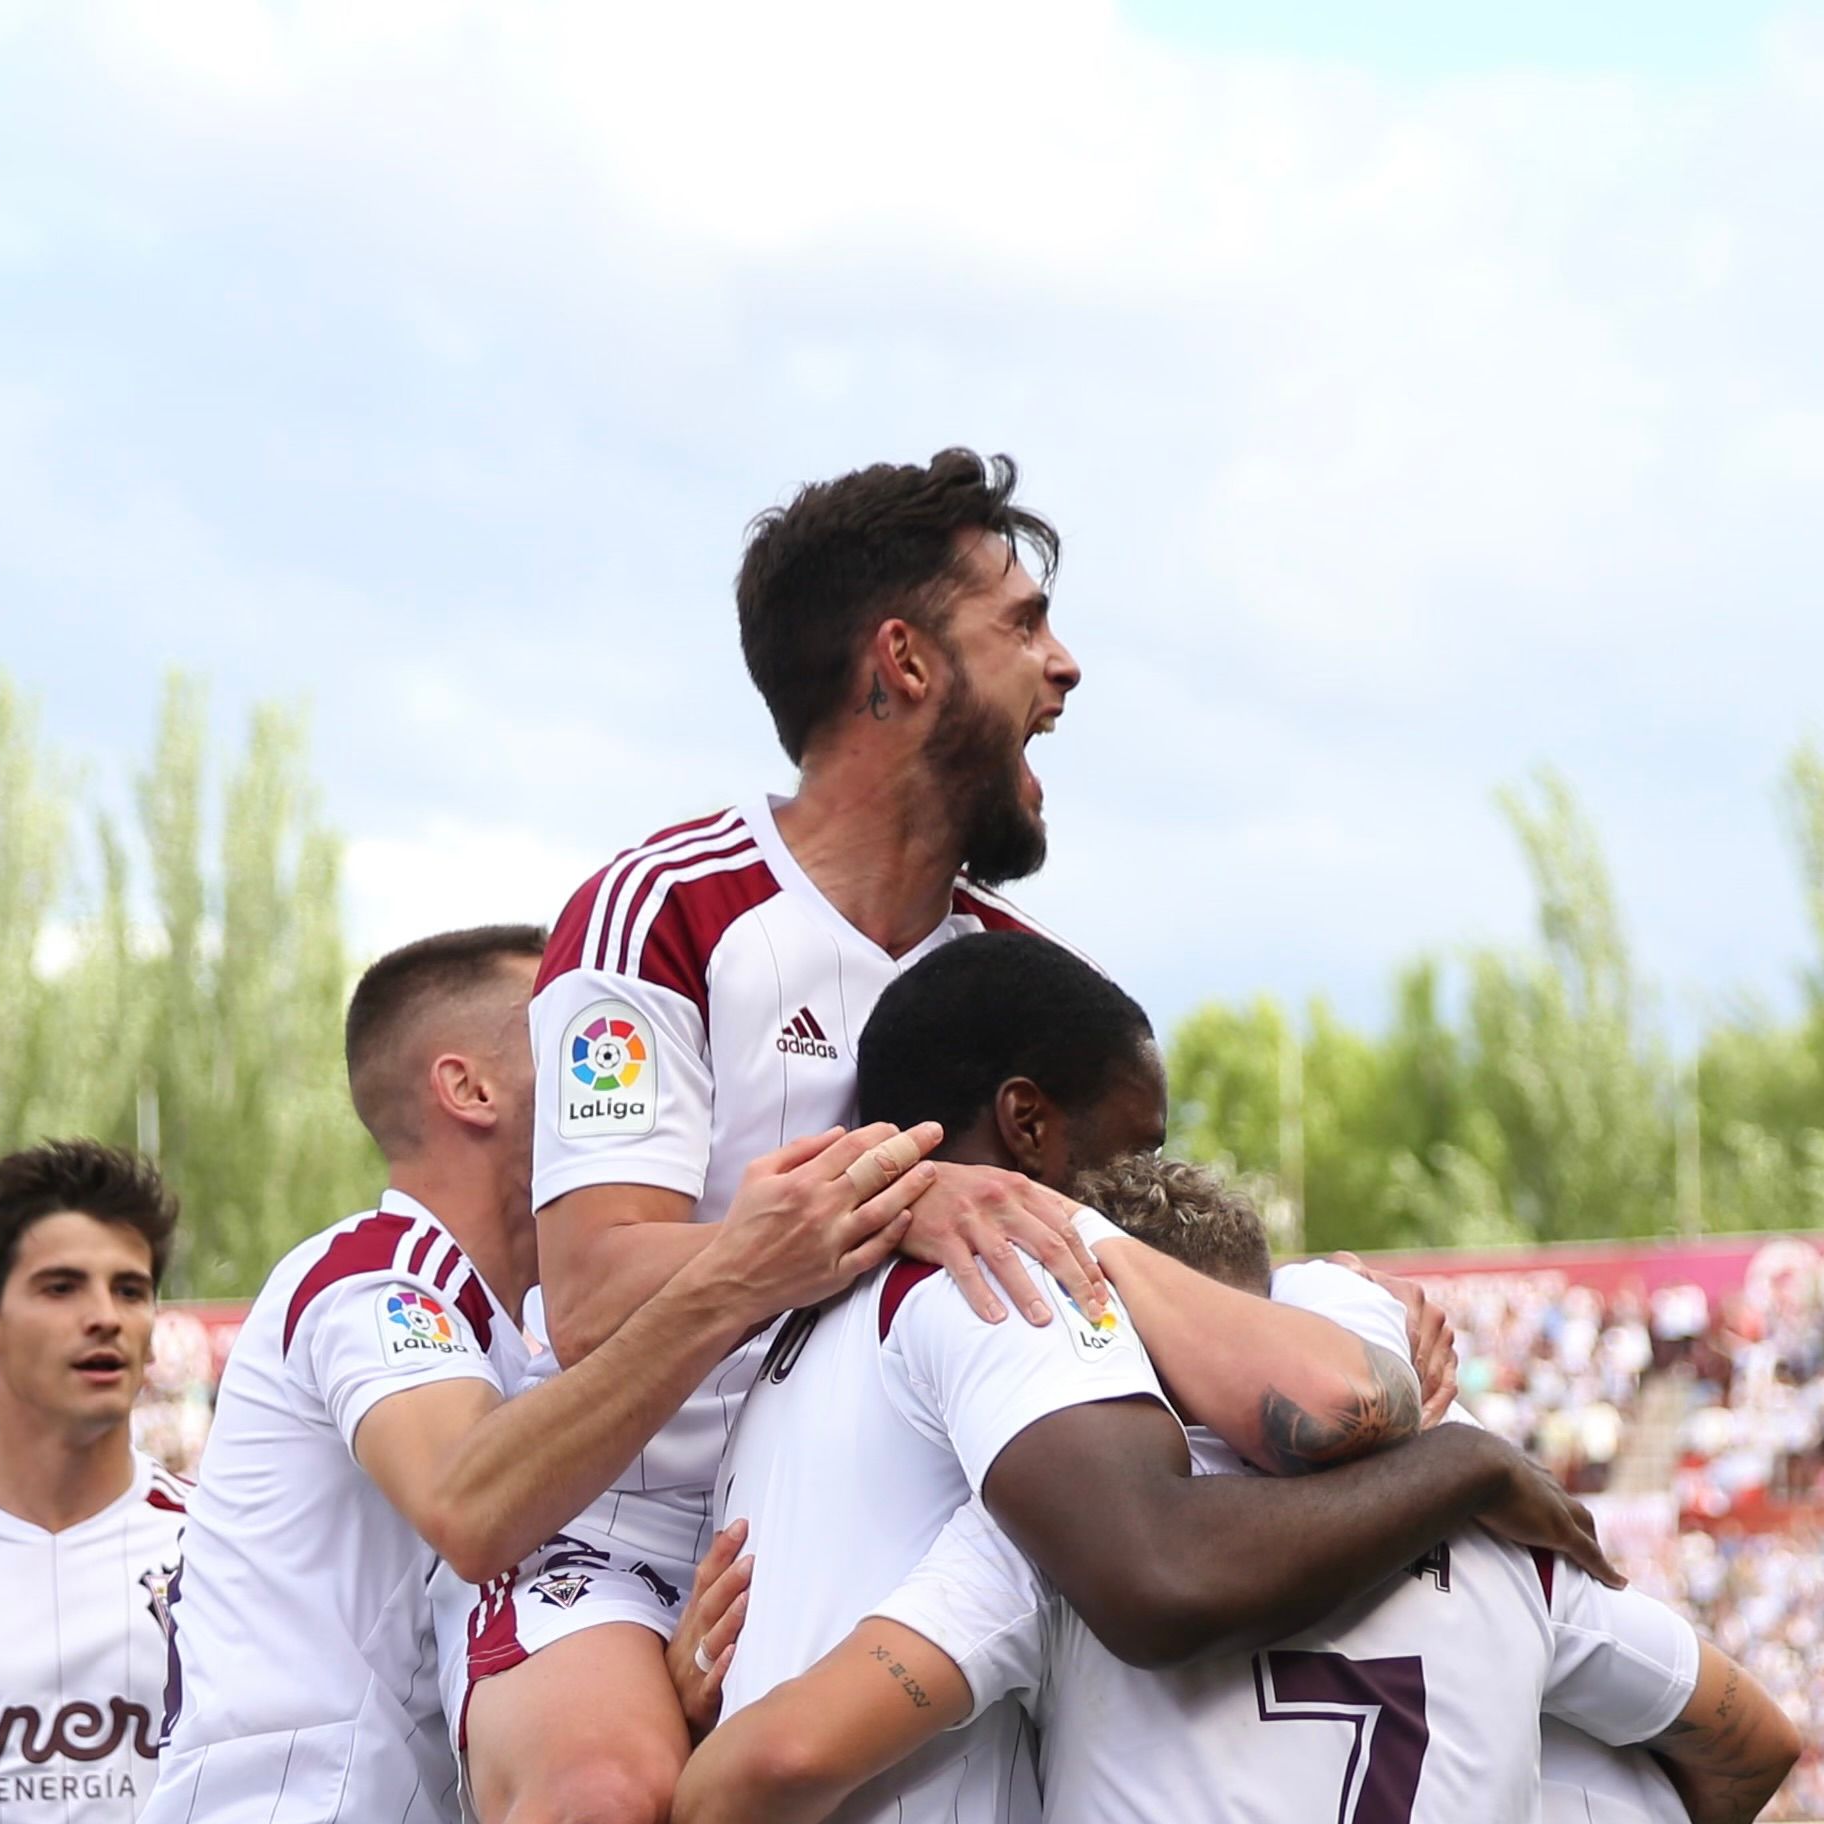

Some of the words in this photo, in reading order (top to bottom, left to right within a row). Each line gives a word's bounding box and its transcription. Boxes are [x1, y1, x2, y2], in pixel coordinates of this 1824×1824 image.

[776, 1035, 839, 1060] adidas
[569, 1097, 645, 1120] LaLiga
[392, 1337, 469, 1354] LaLiga
